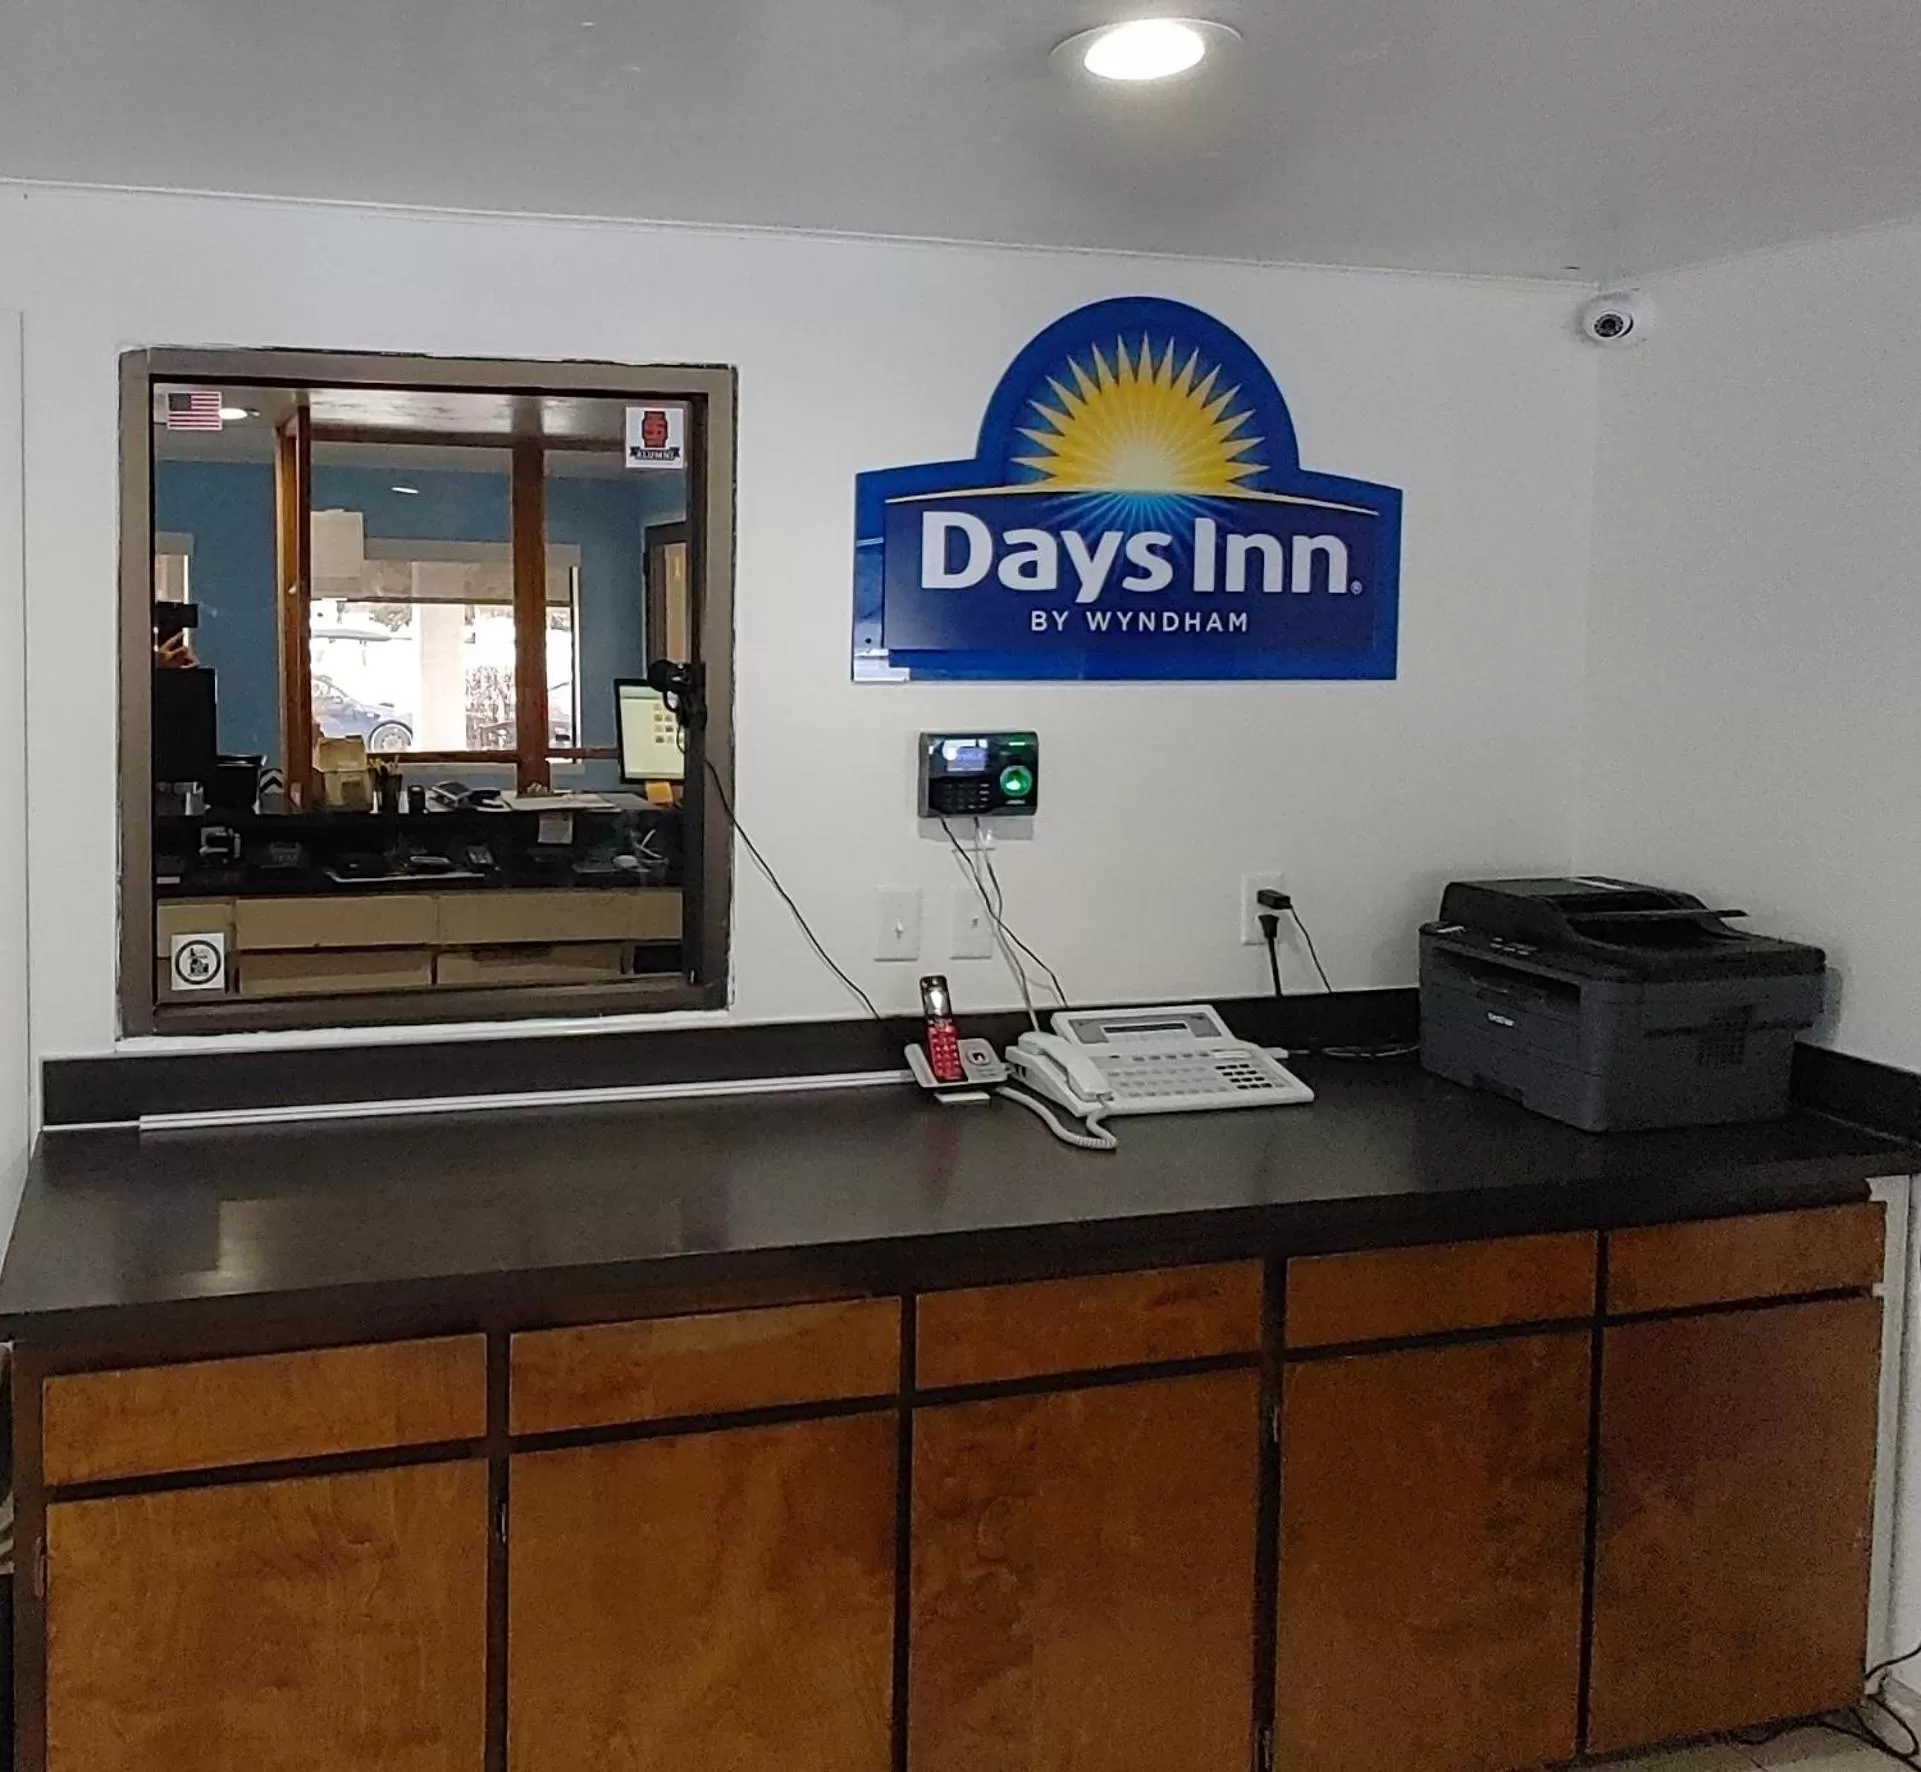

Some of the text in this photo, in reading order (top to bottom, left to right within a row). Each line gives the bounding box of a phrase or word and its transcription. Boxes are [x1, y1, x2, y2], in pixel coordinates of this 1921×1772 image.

[921, 511, 1348, 603] Days Inn
[1031, 610, 1248, 633] BY WYNDHAM
